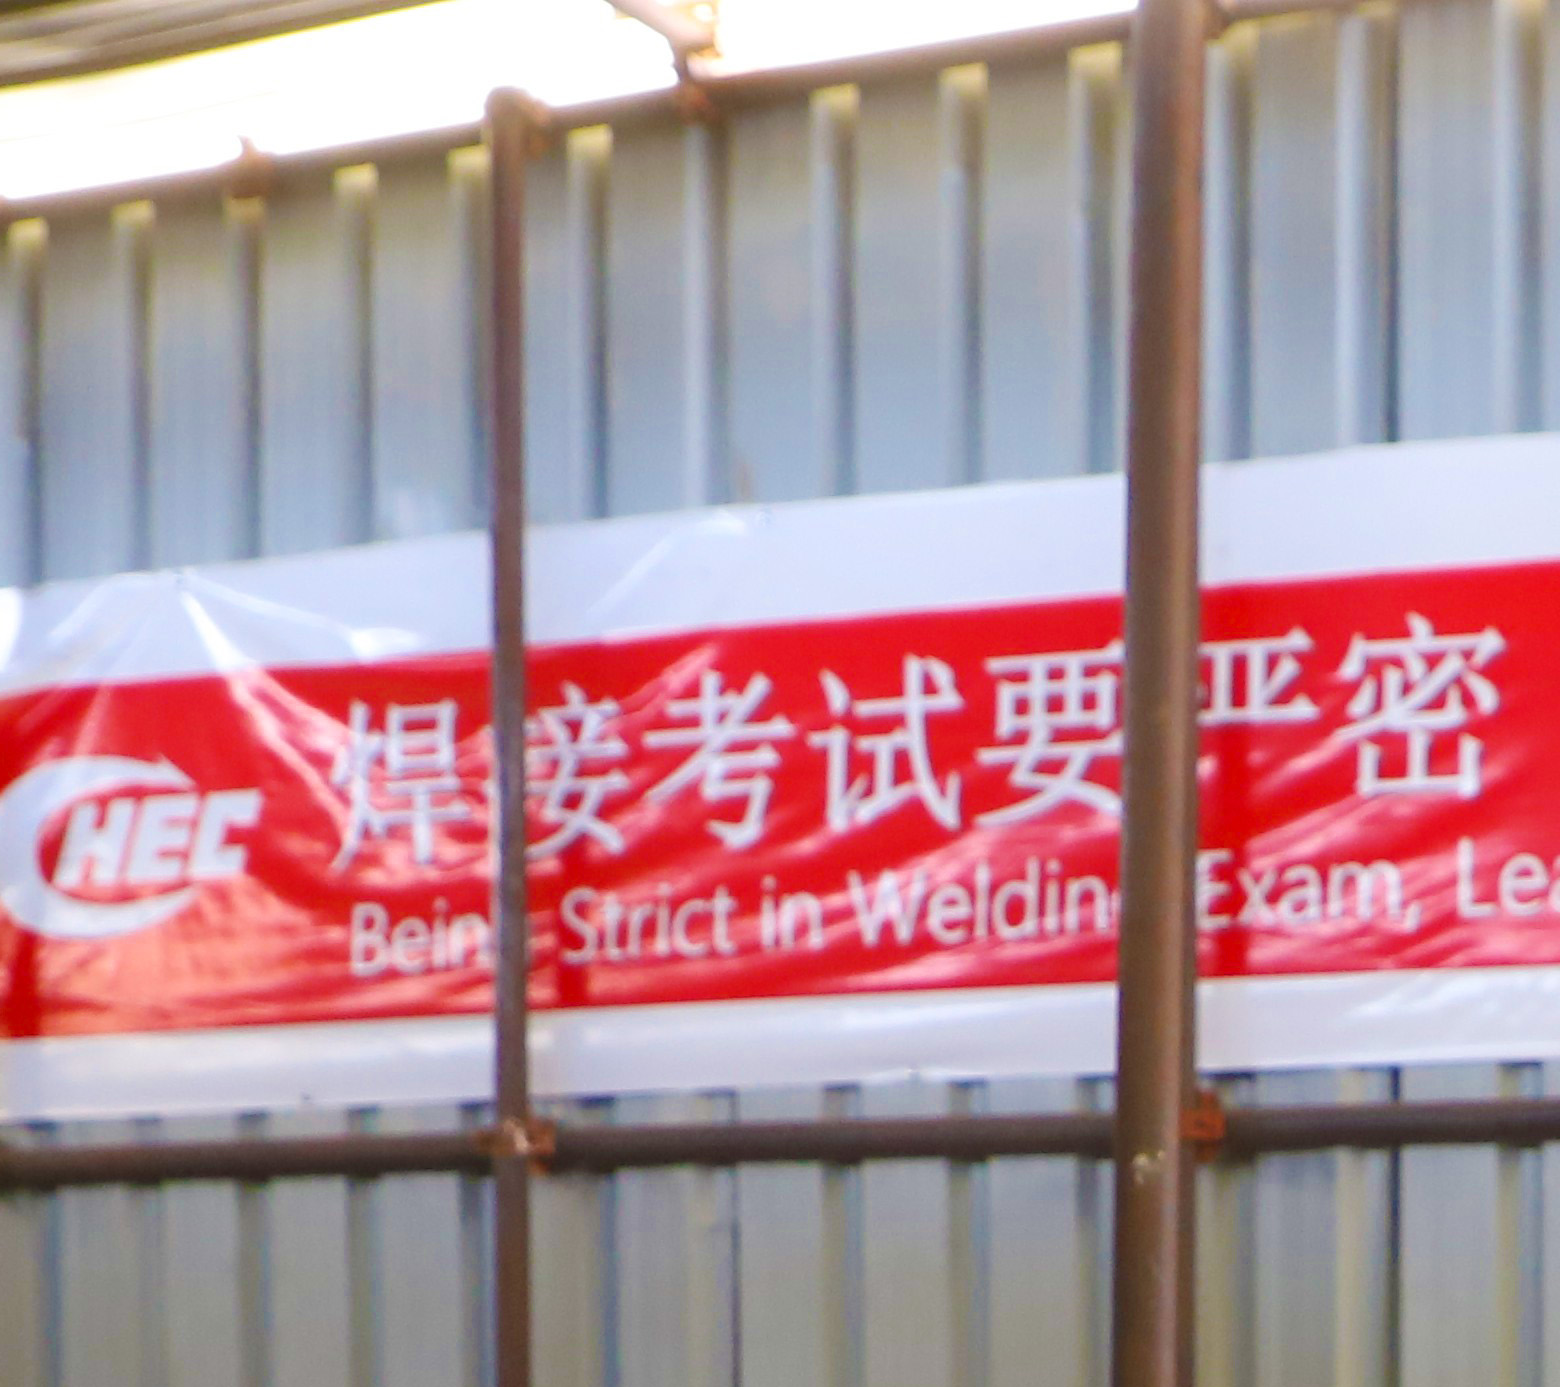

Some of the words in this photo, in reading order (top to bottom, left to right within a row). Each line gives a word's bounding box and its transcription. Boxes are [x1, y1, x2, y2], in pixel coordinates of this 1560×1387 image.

[350, 895, 494, 978] Bein
[560, 881, 737, 965] Strict
[760, 875, 823, 953] in
[848, 856, 1121, 950] Weldin
[1196, 848, 1422, 933] Exam,
